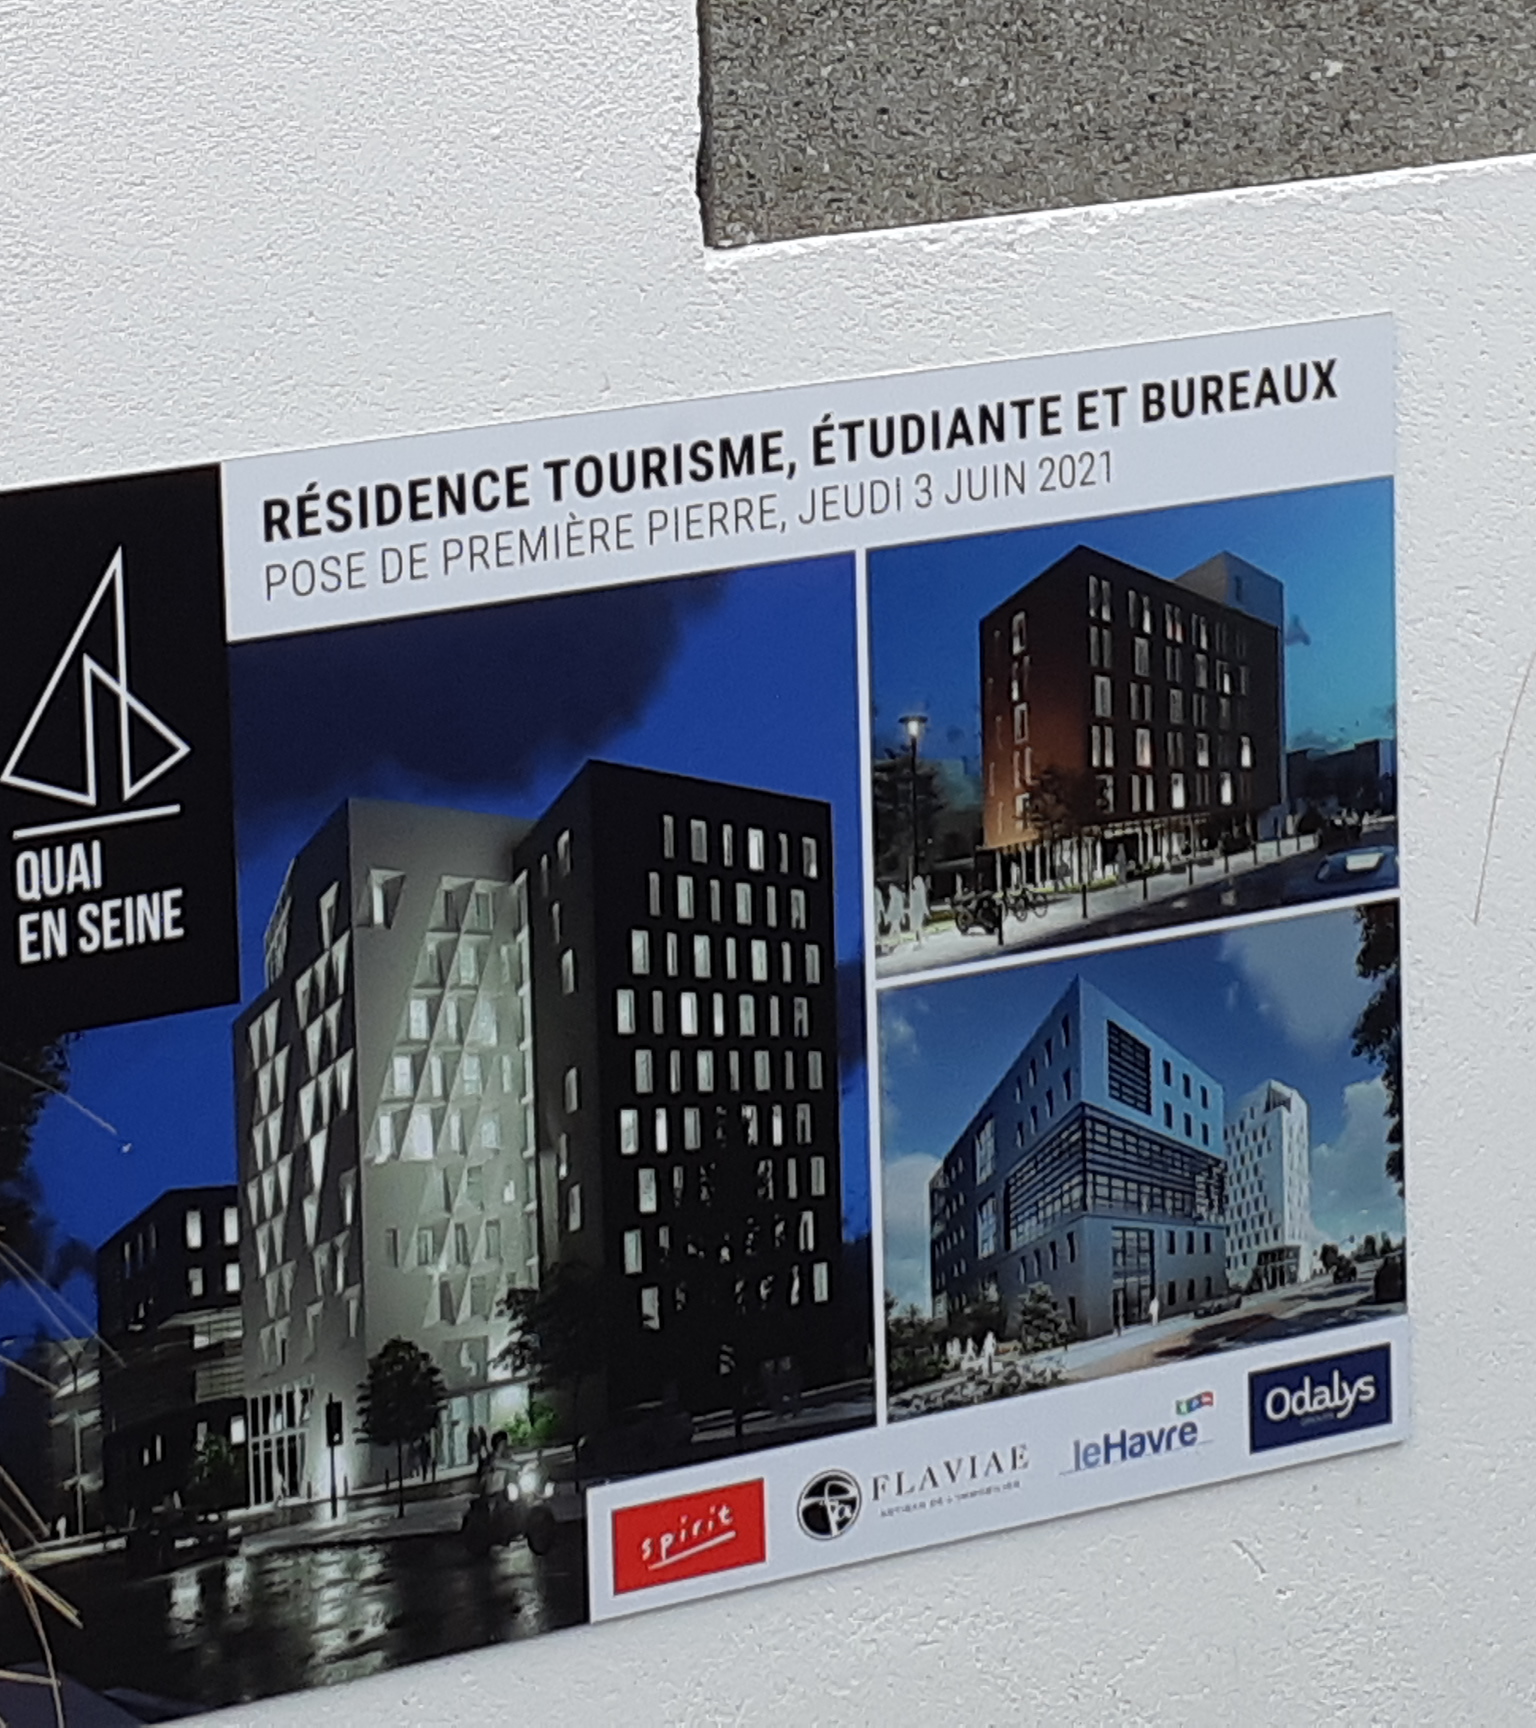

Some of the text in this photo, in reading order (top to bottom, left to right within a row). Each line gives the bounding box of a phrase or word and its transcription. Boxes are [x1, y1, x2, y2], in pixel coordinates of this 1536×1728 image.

[263, 358, 1339, 543] RÉSIDENCE TOURISME, ÉTUDIANTE ET BUREAUX
[265, 449, 1113, 601] POSE DE PREMIÈRE PIERRE, JEUDI 3 JUIN 2021
[16, 839, 103, 902] QUAI
[19, 888, 185, 964] EN SEINE
[1265, 1369, 1376, 1422] Odalys
[872, 1443, 1030, 1501] FLAVIAE
[1073, 1421, 1199, 1472] leHavre
[641, 1503, 734, 1562] spirit
